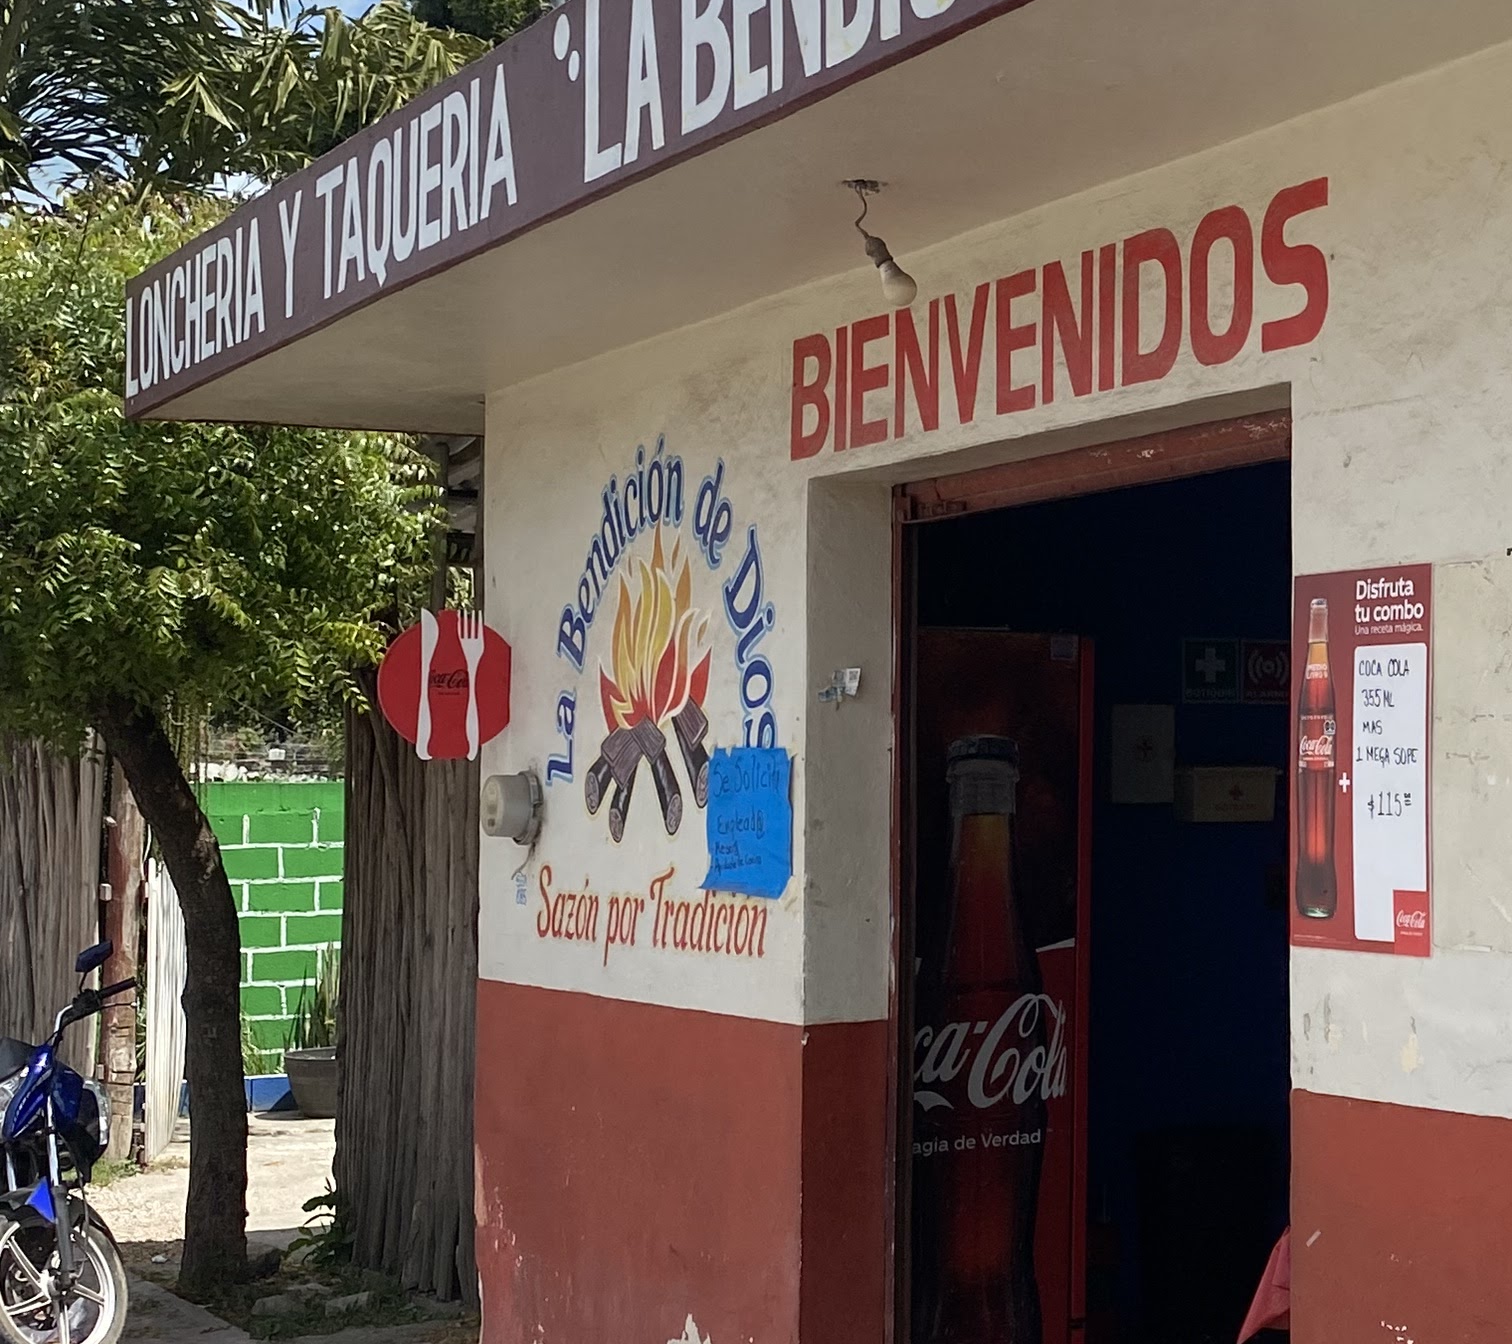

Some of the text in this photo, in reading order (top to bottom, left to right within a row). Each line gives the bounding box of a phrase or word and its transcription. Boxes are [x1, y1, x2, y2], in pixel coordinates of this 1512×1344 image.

[125, 216, 266, 399] LONCHERIA
[278, 189, 302, 319] Y
[315, 63, 518, 288] TAQUERIA
[790, 176, 1330, 462] BIENVENIDOS
[692, 457, 733, 570] de
[555, 433, 685, 672] Bendición
[1356, 576, 1414, 601] Disfruta
[1354, 599, 1424, 623] tu combo
[1354, 624, 1370, 636] Una
[1370, 623, 1394, 634] receta
[1358, 658, 1410, 677] COCA COLA
[547, 690, 577, 786] La
[1362, 719, 1383, 735] MAS
[1366, 745, 1390, 768] MEGA
[1394, 746, 1419, 765] SOPE
[712, 761, 730, 797] Se
[537, 864, 599, 943] Sazón
[602, 895, 645, 967] por
[913, 993, 1068, 1109] ca-Cola
[913, 1128, 1042, 1157] agia de Verdad
